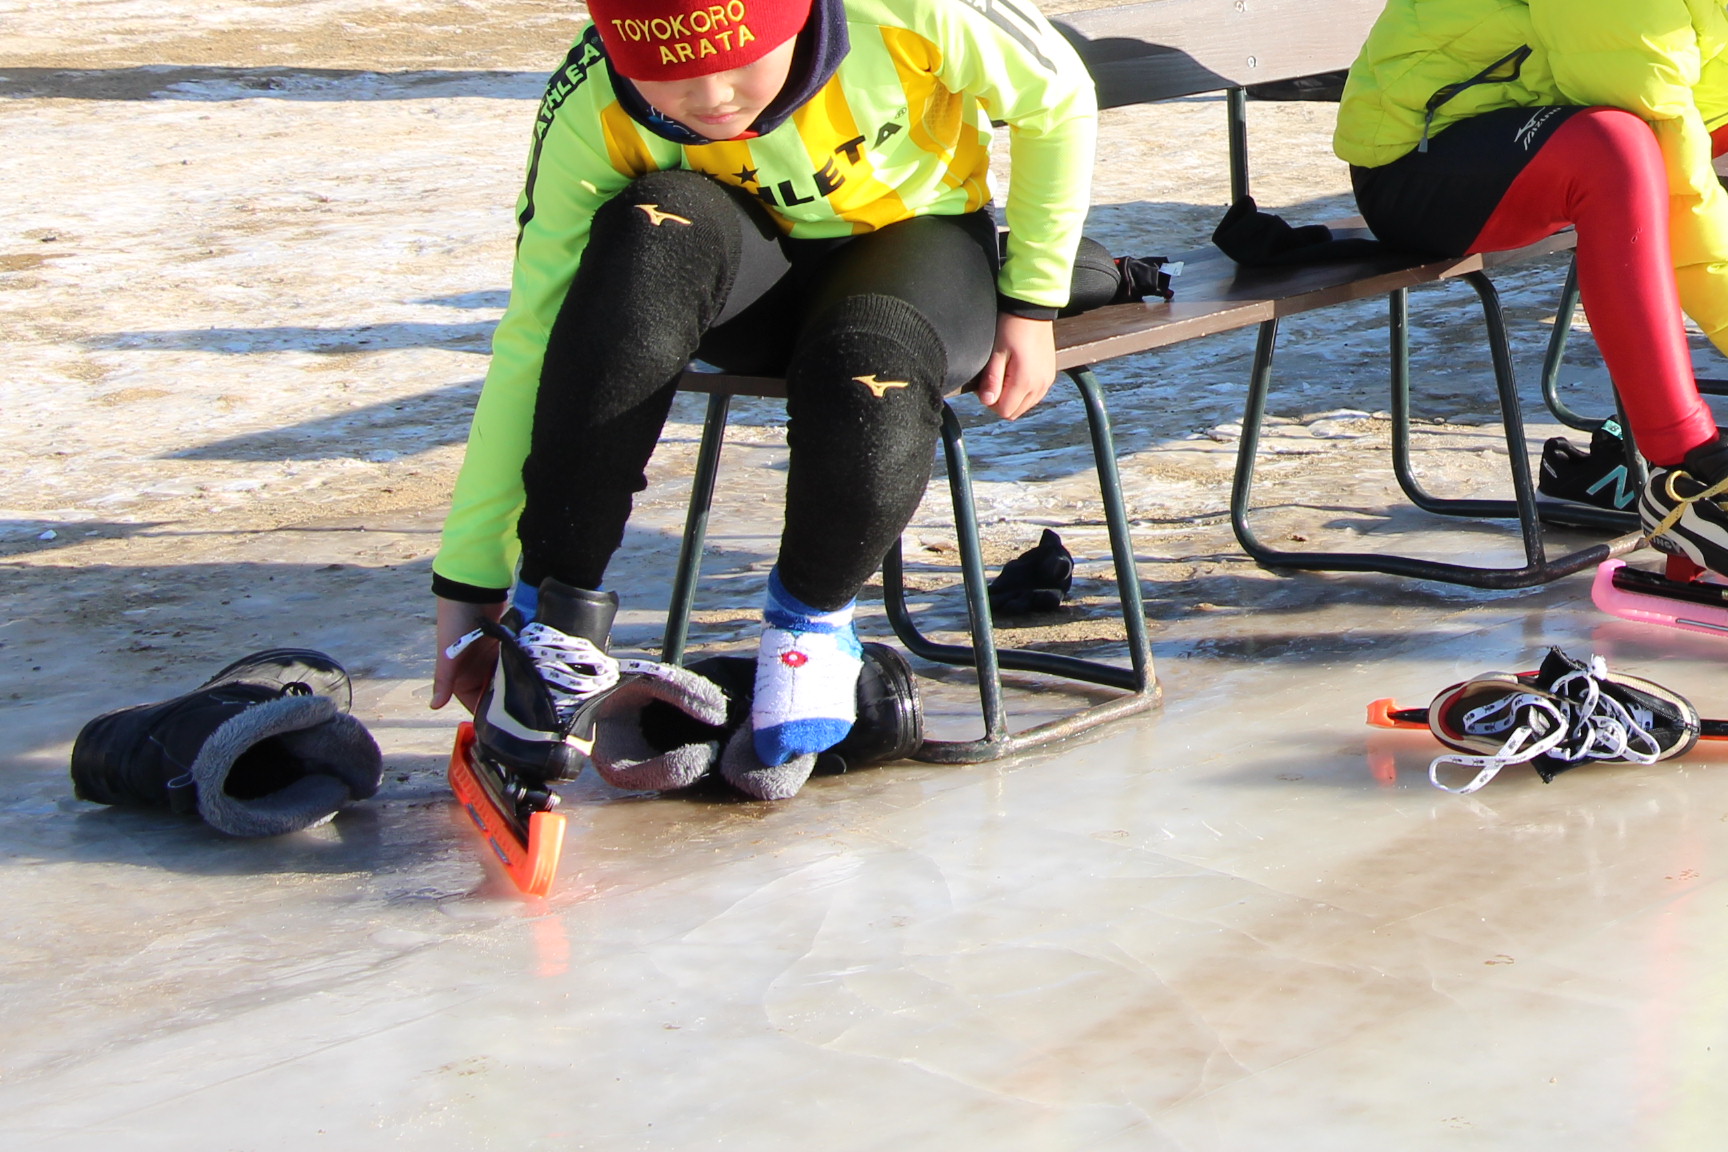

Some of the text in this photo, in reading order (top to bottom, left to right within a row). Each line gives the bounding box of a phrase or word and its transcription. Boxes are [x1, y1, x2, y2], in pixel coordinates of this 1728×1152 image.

[611, 0, 745, 43] TOYOKORO
[659, 24, 756, 65] ARATA
[536, 42, 600, 139] ATHLETA
